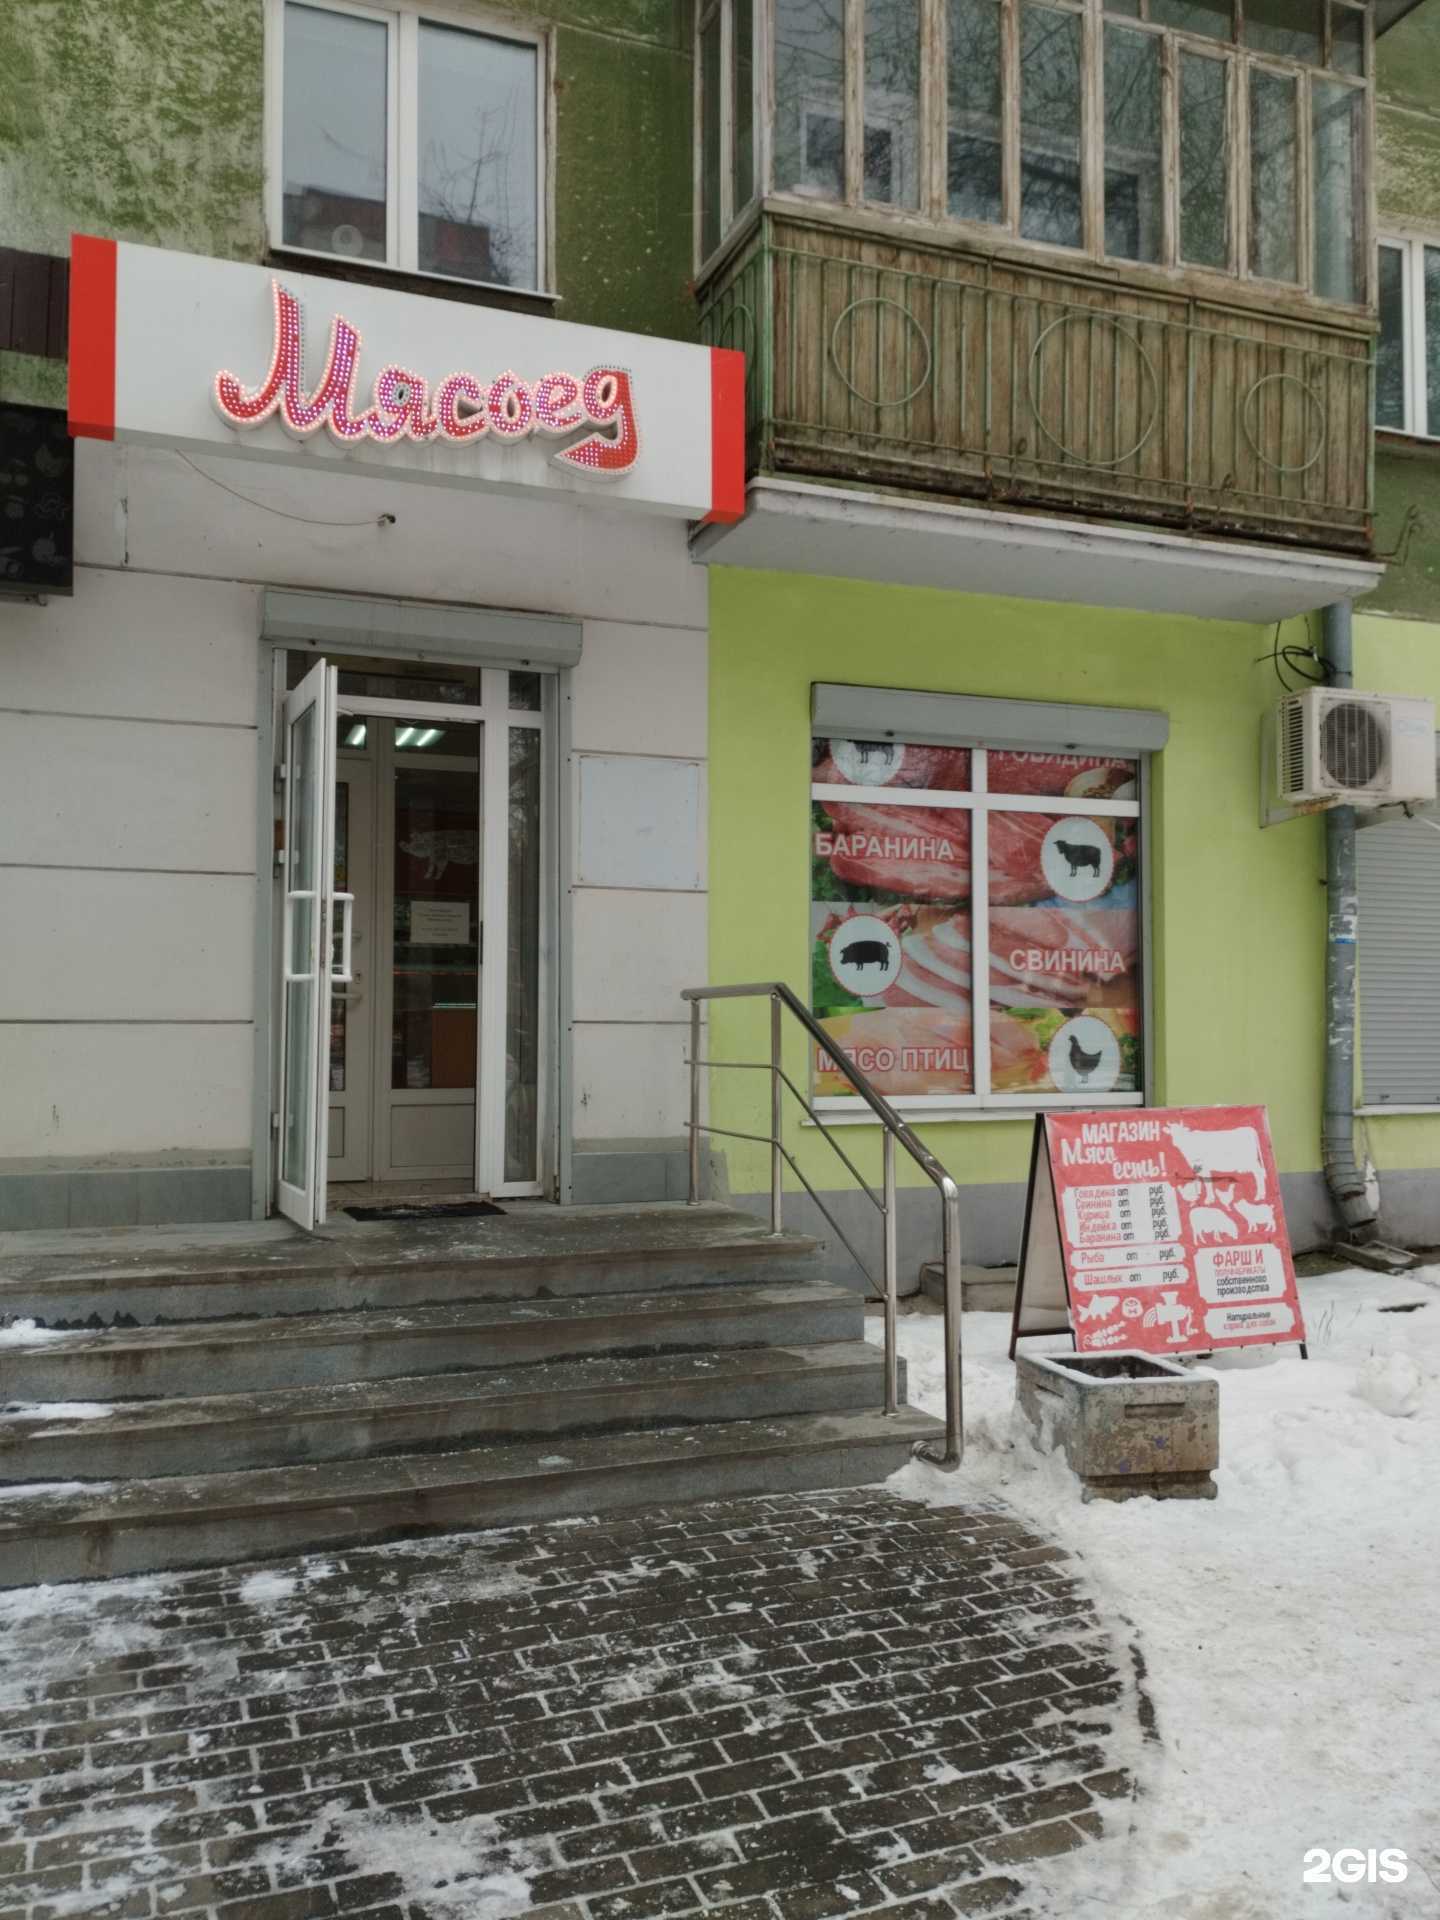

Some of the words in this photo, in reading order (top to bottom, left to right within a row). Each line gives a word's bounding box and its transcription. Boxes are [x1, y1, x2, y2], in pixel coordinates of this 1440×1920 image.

[213, 277, 641, 478] Мясоед
[815, 833, 955, 860] БАРАНИНА
[1009, 949, 1126, 972] СВИНИНА
[1082, 1120, 1160, 1144] МАГАЗИН
[1061, 1138, 1117, 1166] Мясо
[1113, 1152, 1168, 1180] есть!
[1117, 1188, 1129, 1197] от
[1118, 1199, 1130, 1207] от
[1120, 1209, 1132, 1218] от
[1121, 1221, 1133, 1230] от
[1123, 1232, 1135, 1241] от
[1126, 1252, 1139, 1261] от
[1213, 1250, 1251, 1267] ФАРШ
[1255, 1249, 1264, 1264] И
[1129, 1273, 1142, 1282] от
